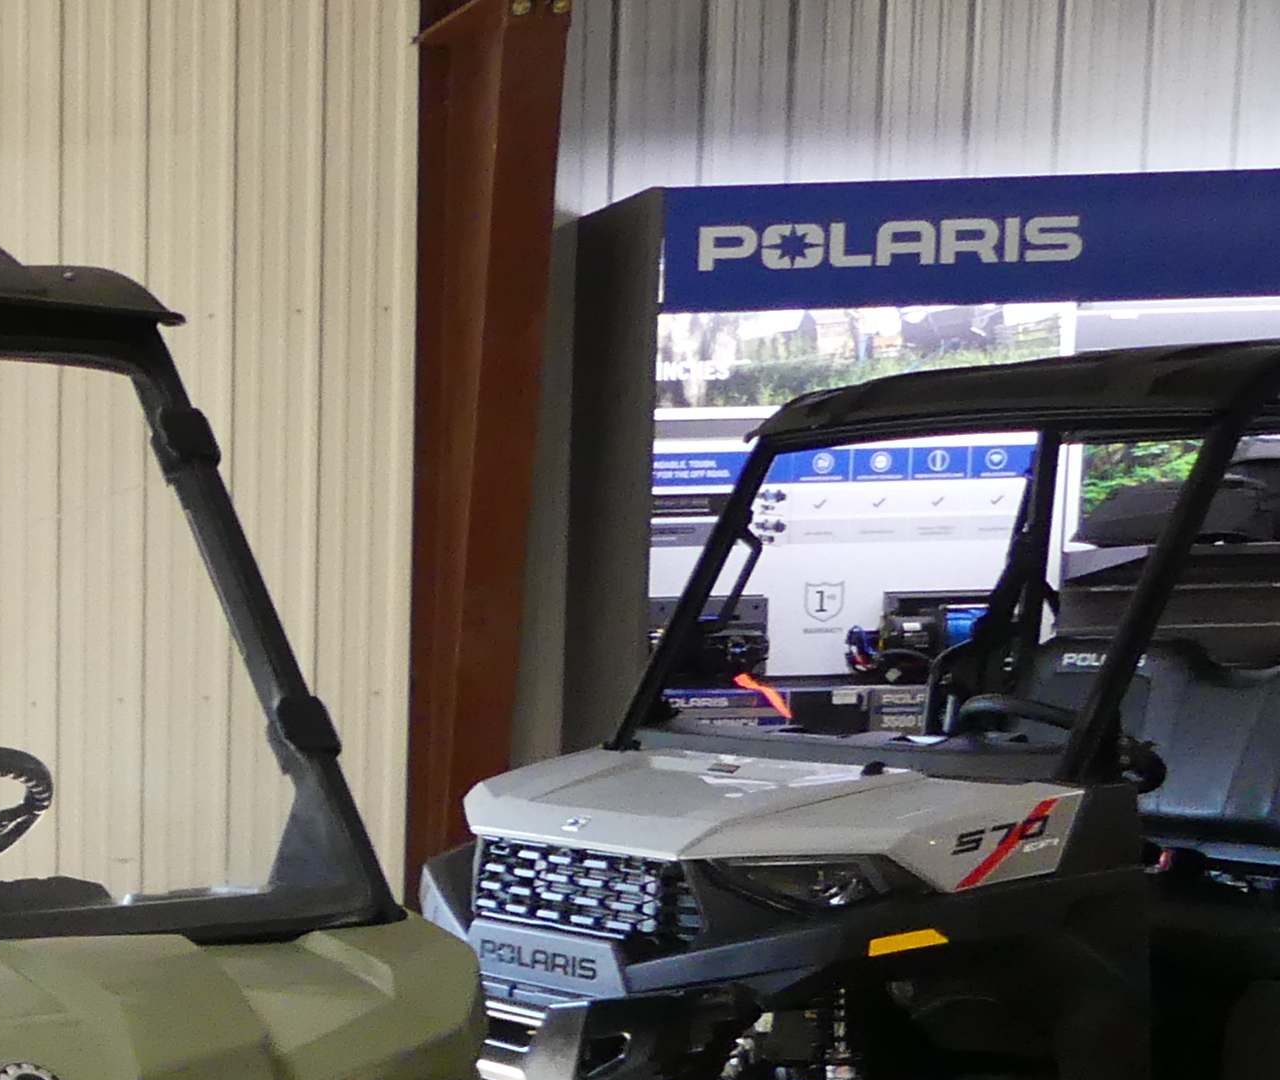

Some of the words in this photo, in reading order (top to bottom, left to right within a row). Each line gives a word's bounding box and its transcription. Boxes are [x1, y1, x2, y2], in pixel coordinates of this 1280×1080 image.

[697, 215, 1083, 272] POLARIS
[656, 360, 729, 382] INCHES
[668, 697, 729, 708] OLARIS
[480, 938, 598, 981] POLARIS
